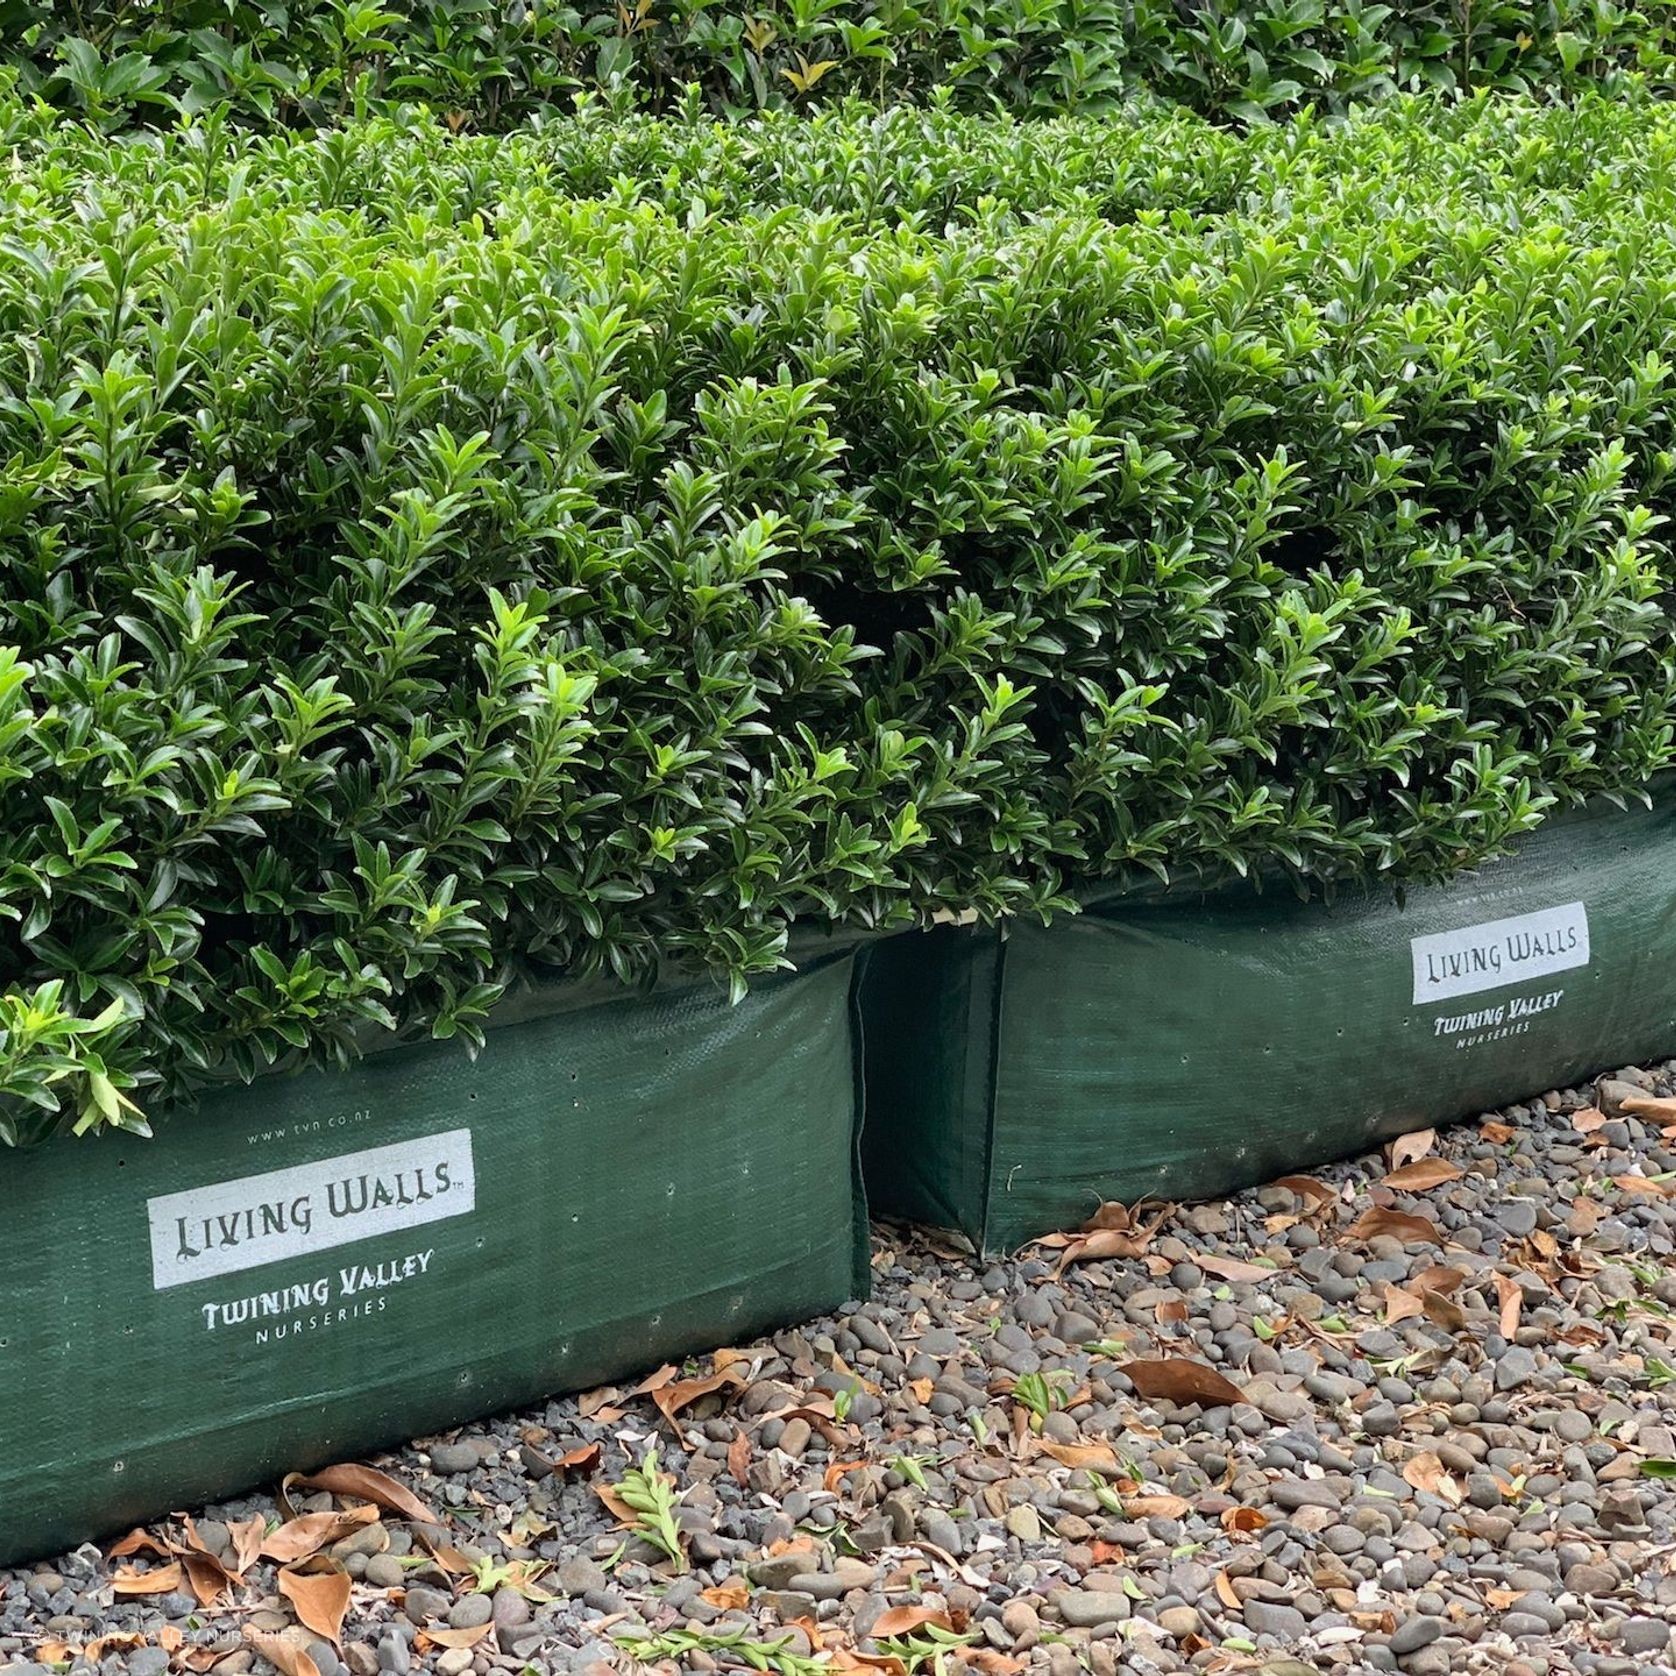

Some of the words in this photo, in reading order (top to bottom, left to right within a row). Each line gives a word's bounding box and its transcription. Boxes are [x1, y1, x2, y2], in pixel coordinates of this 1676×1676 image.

[1427, 945, 1501, 983] LIVING
[1506, 927, 1577, 962] WALLS
[1433, 1005, 1504, 1036] TWINING
[1508, 990, 1564, 1019] VALLEY
[1456, 1021, 1530, 1048] NURSERIES
[247, 1110, 371, 1144] wwwtvnco.nz
[175, 1195, 312, 1263] LIVING
[326, 1162, 451, 1218] WALLS
[202, 1277, 329, 1330] TWINING
[339, 1249, 434, 1296] VALLEY
[255, 1297, 388, 1344] NURSERIES
